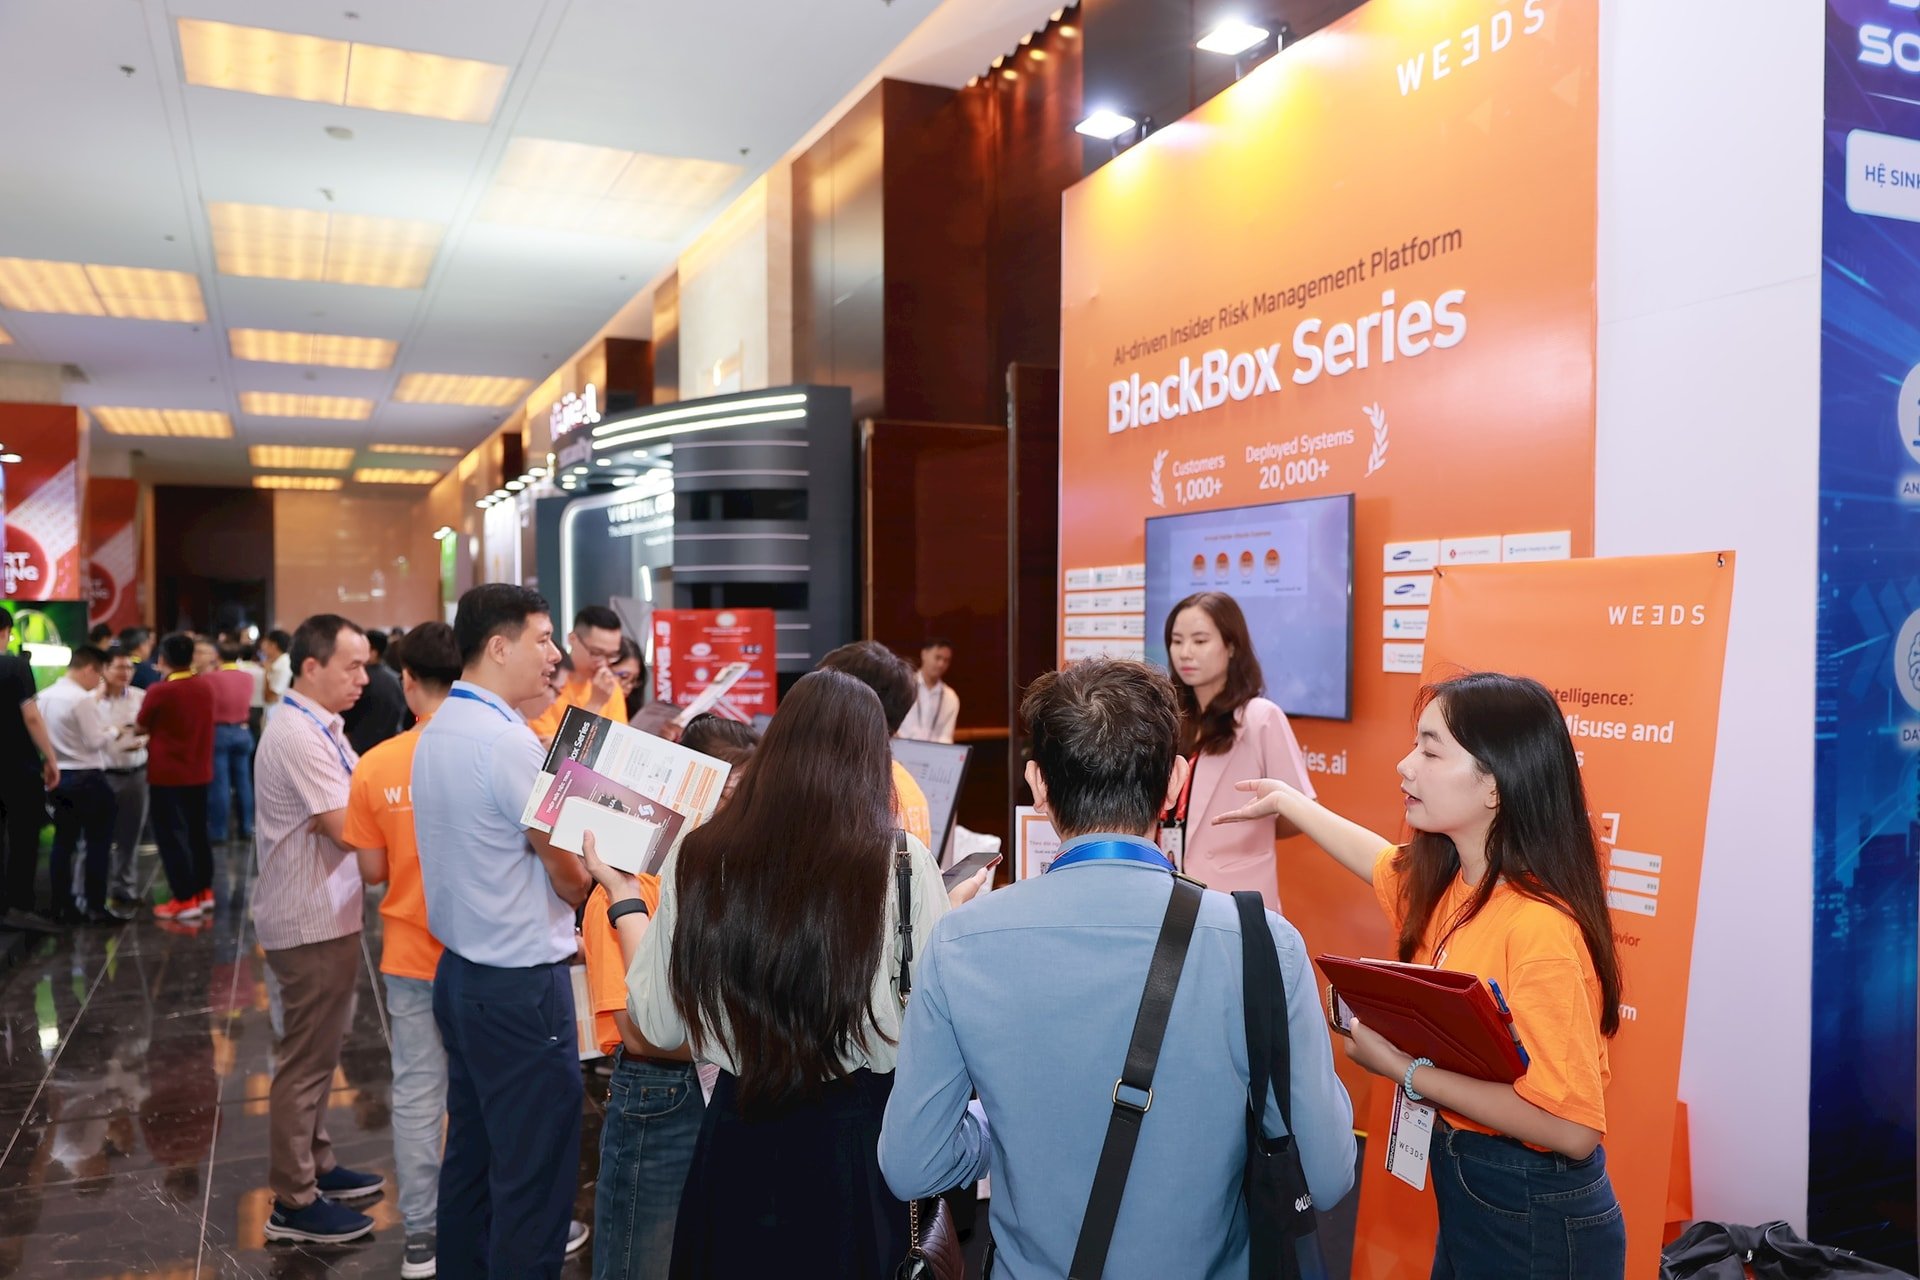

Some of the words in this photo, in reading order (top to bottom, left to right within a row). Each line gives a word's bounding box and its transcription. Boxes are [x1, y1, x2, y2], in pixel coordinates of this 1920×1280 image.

[1113, 333, 1168, 367] AI-driven
[1170, 313, 1215, 348] Insider
[1218, 301, 1250, 330] Risk
[1252, 259, 1366, 320] Management
[1371, 227, 1463, 279] Platform
[1108, 341, 1282, 435] BlackBox
[1291, 288, 1468, 385] Series
[1245, 437, 1299, 465] Deployed
[1300, 428, 1355, 454] Systems
[1172, 454, 1225, 478] Customers
[1259, 457, 1330, 490] 20,000+
[1174, 476, 1223, 505] 1,000+
[1554, 687, 1634, 708] telligence:
[1631, 720, 1675, 744] and
